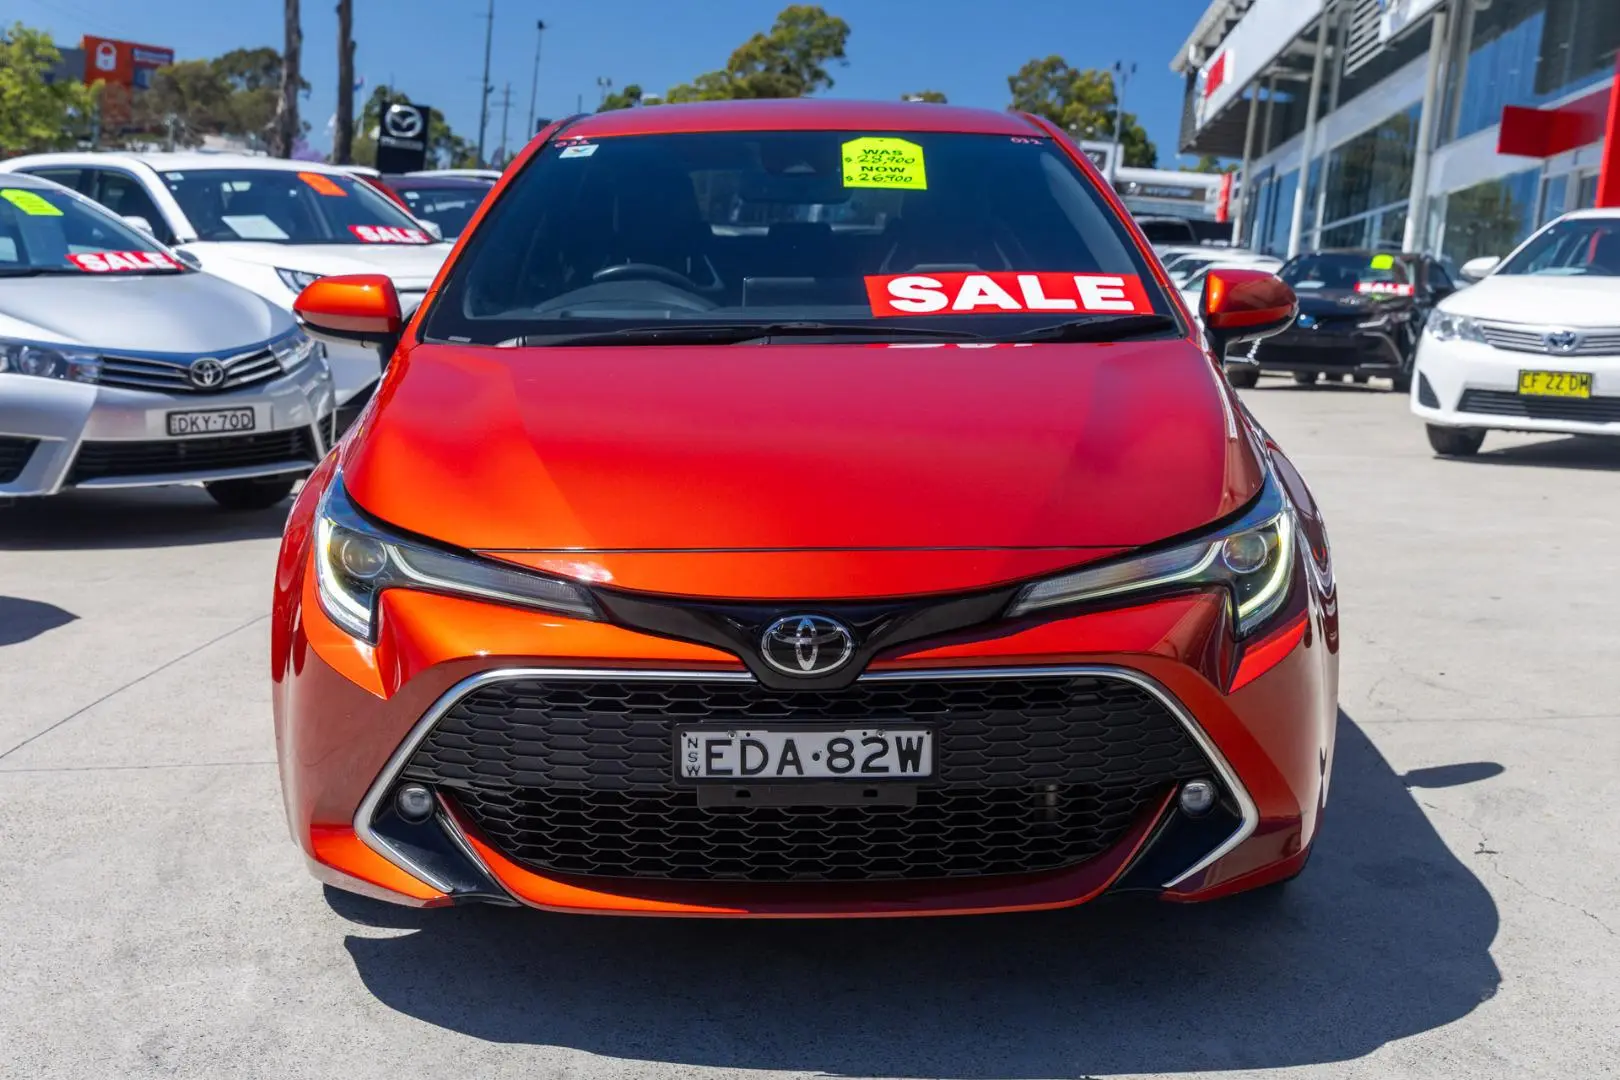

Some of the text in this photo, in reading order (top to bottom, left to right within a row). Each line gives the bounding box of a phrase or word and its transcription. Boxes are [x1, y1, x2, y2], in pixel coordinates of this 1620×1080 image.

[356, 225, 430, 244] SALE
[77, 252, 178, 271] SALE
[887, 274, 1135, 313] SALE
[1357, 282, 1410, 296] SALE
[687, 738, 700, 777] NSW
